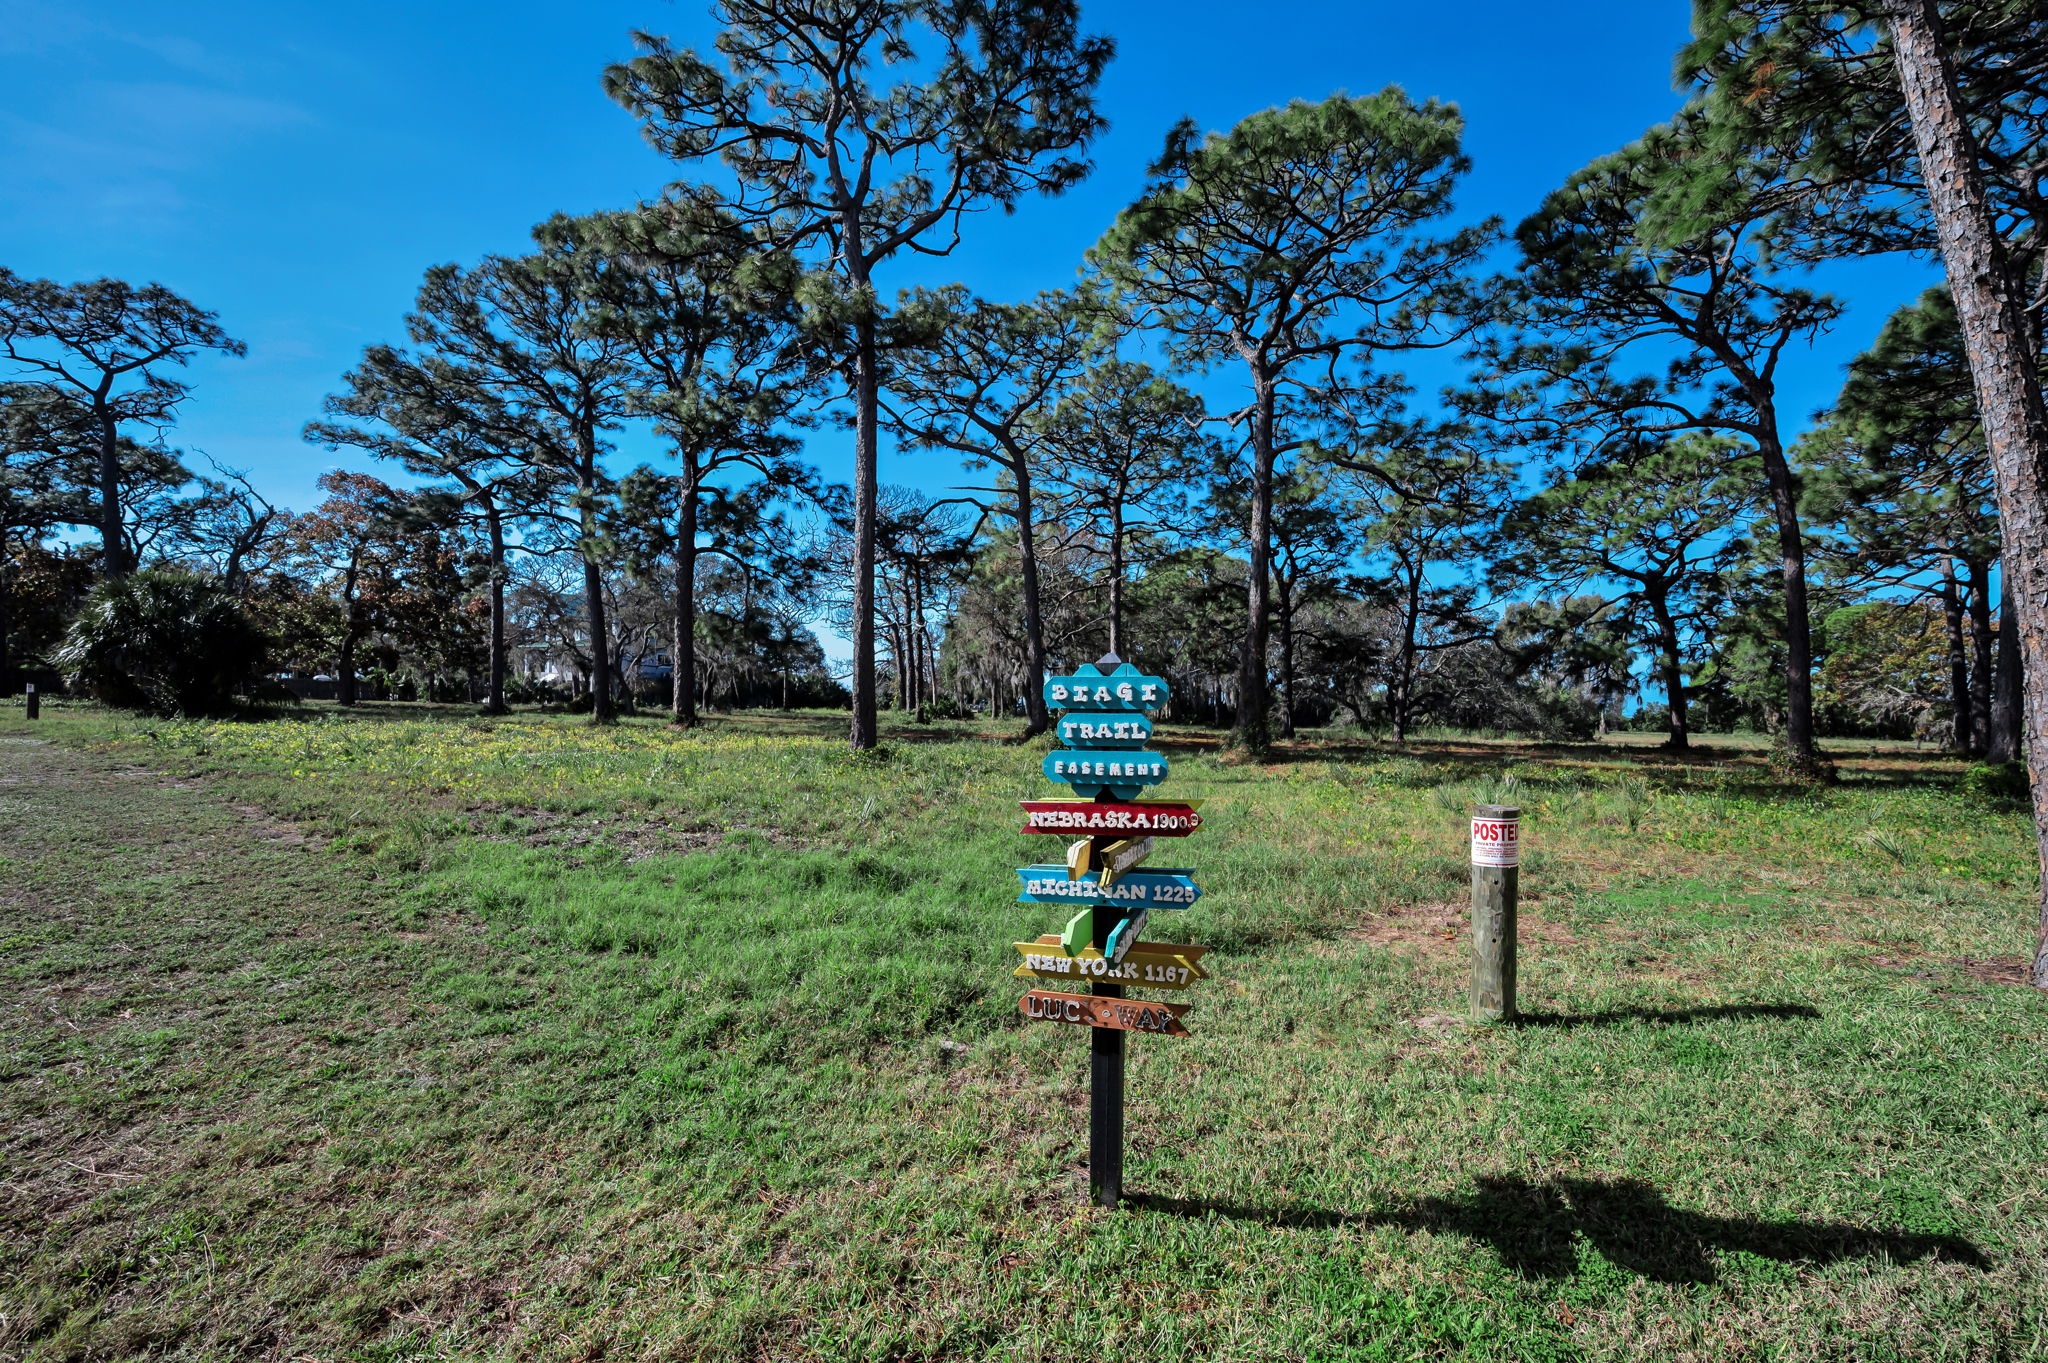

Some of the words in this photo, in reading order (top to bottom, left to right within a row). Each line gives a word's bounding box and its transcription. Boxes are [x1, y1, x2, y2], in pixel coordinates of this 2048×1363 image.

[1052, 682, 1157, 702] BIAGI
[1063, 722, 1147, 740] TRAIL
[1054, 761, 1161, 776] EASEMENT
[1030, 811, 1152, 829] NEBRASKA
[1153, 886, 1195, 903] 1225
[1025, 954, 1072, 973] NEW
[1144, 964, 1189, 985] 1167
[1114, 1003, 1172, 1033] WAY
